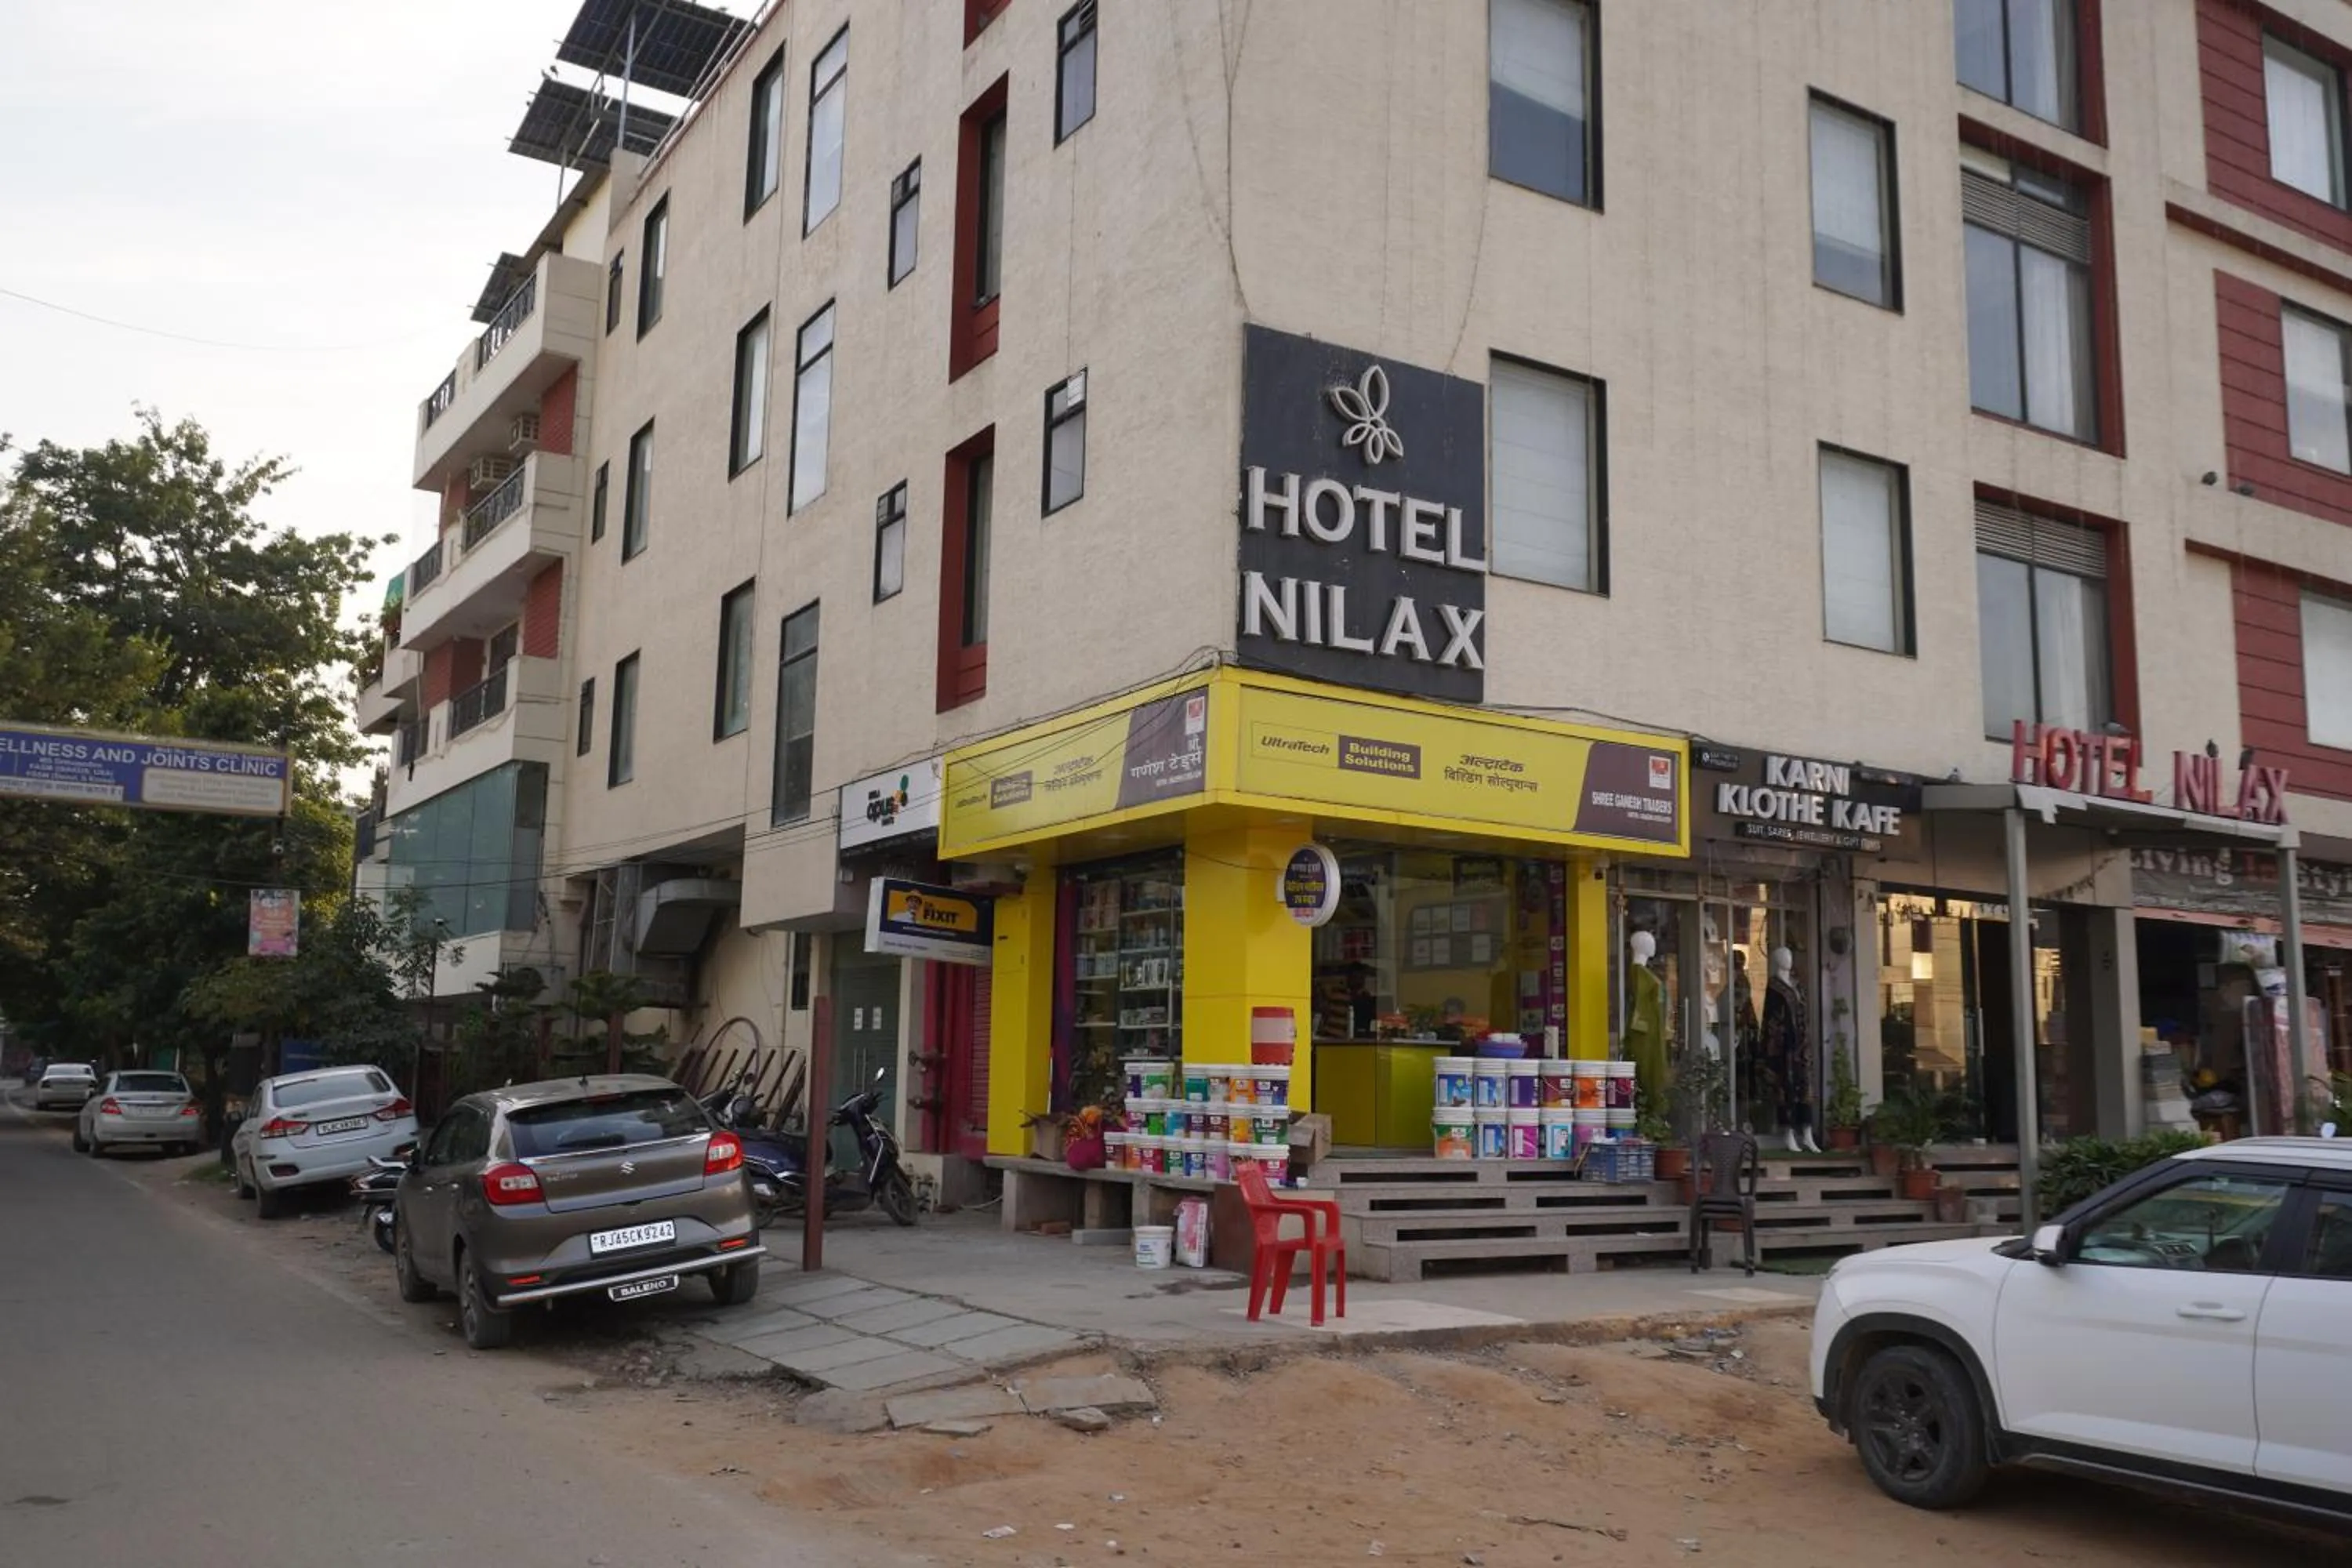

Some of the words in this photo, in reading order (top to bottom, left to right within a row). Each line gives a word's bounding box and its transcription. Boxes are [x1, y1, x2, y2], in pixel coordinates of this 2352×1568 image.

[1244, 465, 1487, 573] HOTEL
[1242, 570, 1486, 670] NILAX
[1261, 735, 1330, 755] UltraTech
[1348, 742, 1410, 763] Building
[93, 747, 136, 763] AND
[141, 752, 210, 771] JOINTS
[216, 758, 278, 776] CLINIC
[1345, 753, 1415, 772] Solutions
[2010, 720, 2153, 804] HOTEL
[2172, 750, 2290, 825] NILAX
[1766, 756, 1850, 797] KARNI
[1717, 784, 1824, 826] KLOTHE
[1831, 800, 1901, 836] KAFE
[599, 1223, 673, 1248] RJ45CK9242
[620, 1279, 667, 1296] BALENO
